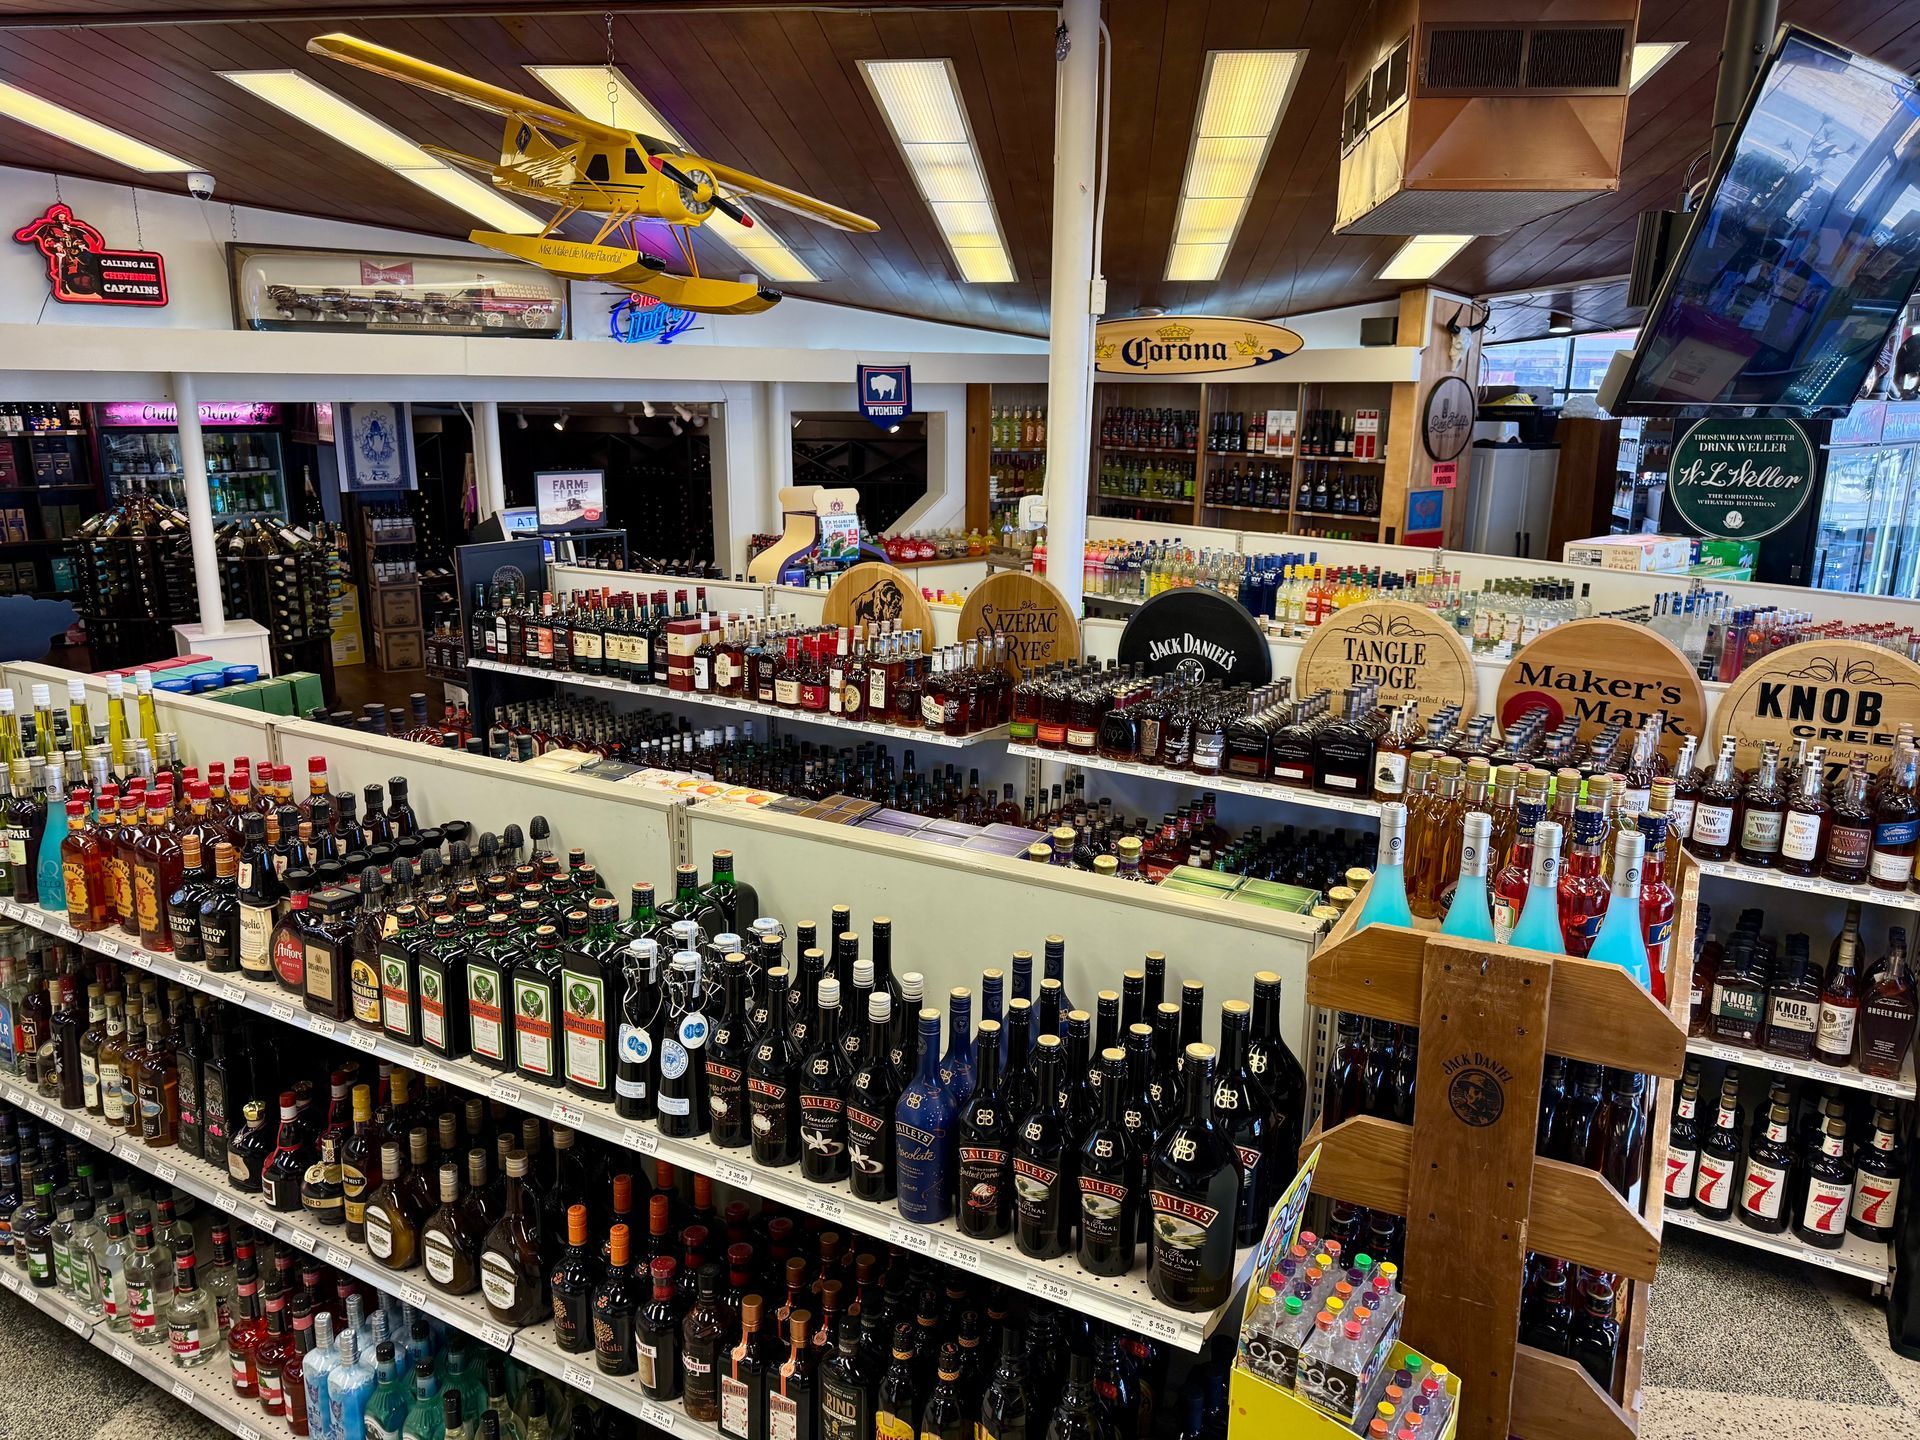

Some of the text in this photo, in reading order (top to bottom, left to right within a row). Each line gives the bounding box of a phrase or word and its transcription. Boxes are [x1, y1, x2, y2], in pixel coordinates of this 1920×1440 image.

[579, 249, 595, 260] More
[101, 260, 138, 268] CALLING
[103, 271, 156, 281] CHEYENNE
[364, 269, 412, 281] Budweiser
[103, 284, 159, 294] CAPTAINS
[1121, 336, 1228, 369] Corona
[201, 403, 240, 420] Wine
[868, 406, 904, 416] WYOMING
[1699, 442, 1787, 453] DRINK WELLER
[1433, 463, 1456, 474] WYOMING
[552, 480, 584, 490] FARM
[1436, 475, 1452, 485] PROUD
[553, 489, 588, 500] FLASK
[1736, 500, 1777, 508] BOURBON
[516, 517, 533, 527] AT
[980, 604, 1058, 637] SAZERAC
[1004, 634, 1042, 669] RYE
[1149, 632, 1237, 671] JACK DANIEL'S
[1343, 637, 1427, 666] TANGLE
[1350, 663, 1417, 690] RIDGE
[1515, 661, 1682, 705] Maker's
[803, 692, 814, 700] 46
[1756, 681, 1883, 728] KNOB
[1573, 697, 1690, 736] Mark
[1104, 727, 1124, 741] 1792
[1698, 808, 1729, 818] WYOMING
[1749, 815, 1780, 824] WYOMING
[1696, 824, 1726, 833] WHISKEY
[1833, 829, 1868, 840] WYOMING
[1788, 831, 1812, 840] WHISKEY
[1831, 845, 1865, 855] WHISKEY
[169, 915, 196, 926] URBON
[170, 923, 191, 933] REAM
[201, 926, 226, 937] URBON
[202, 934, 221, 944] REAM
[353, 996, 373, 1007] HONEY
[1722, 990, 1753, 1006] KNOB
[1727, 1002, 1758, 1012] CREEK
[1776, 1000, 1808, 1016] KNOB
[1780, 1012, 1812, 1022] CREEK
[1894, 1011, 1911, 1021] ENVY
[517, 1018, 550, 1033] Jägermeister
[565, 1014, 603, 1035] Jägermeister
[1809, 1021, 1815, 1030] 9
[579, 1037, 586, 1045] 56
[1442, 1054, 1471, 1075] JACK
[802, 1097, 842, 1110] BAILEYS
[1682, 1105, 1690, 1116] 7
[802, 1111, 839, 1124] Vanilla
[1720, 1114, 1729, 1126] 7
[896, 1123, 930, 1142] AILEYS
[1771, 1128, 1779, 1140] 7
[1832, 1144, 1840, 1155] 7
[1881, 1138, 1890, 1149] 7
[962, 1149, 1007, 1161] BAILEYS
[960, 1167, 979, 1179] Salted
[1665, 1158, 1688, 1194] 7
[1080, 1179, 1126, 1197] BAILEYS
[1699, 1165, 1726, 1204] 7
[1747, 1173, 1776, 1213] 7
[825, 1204, 841, 1215] 30.59
[1152, 1194, 1213, 1222] BAILEYS
[1860, 1185, 1892, 1224] 7
[1813, 1194, 1845, 1231] 7
[1082, 1218, 1118, 1232] ORIGINAL
[909, 1235, 927, 1247] 30.59
[958, 1251, 977, 1263] 30.59
[1154, 1246, 1202, 1267] ORIGINAL
[1168, 1248, 1184, 1258] The
[1173, 1261, 1193, 1272] Cream
[1049, 1285, 1068, 1297] 30.59
[1155, 1322, 1176, 1334] 55.59
[1251, 1367, 1280, 1384] FRUIT PACK
[723, 1384, 747, 1396] COINTREAU
[771, 1400, 796, 1413] COINTREAU
[825, 1394, 856, 1418] RIND
[1309, 1394, 1339, 1412] FRUIT PACK
